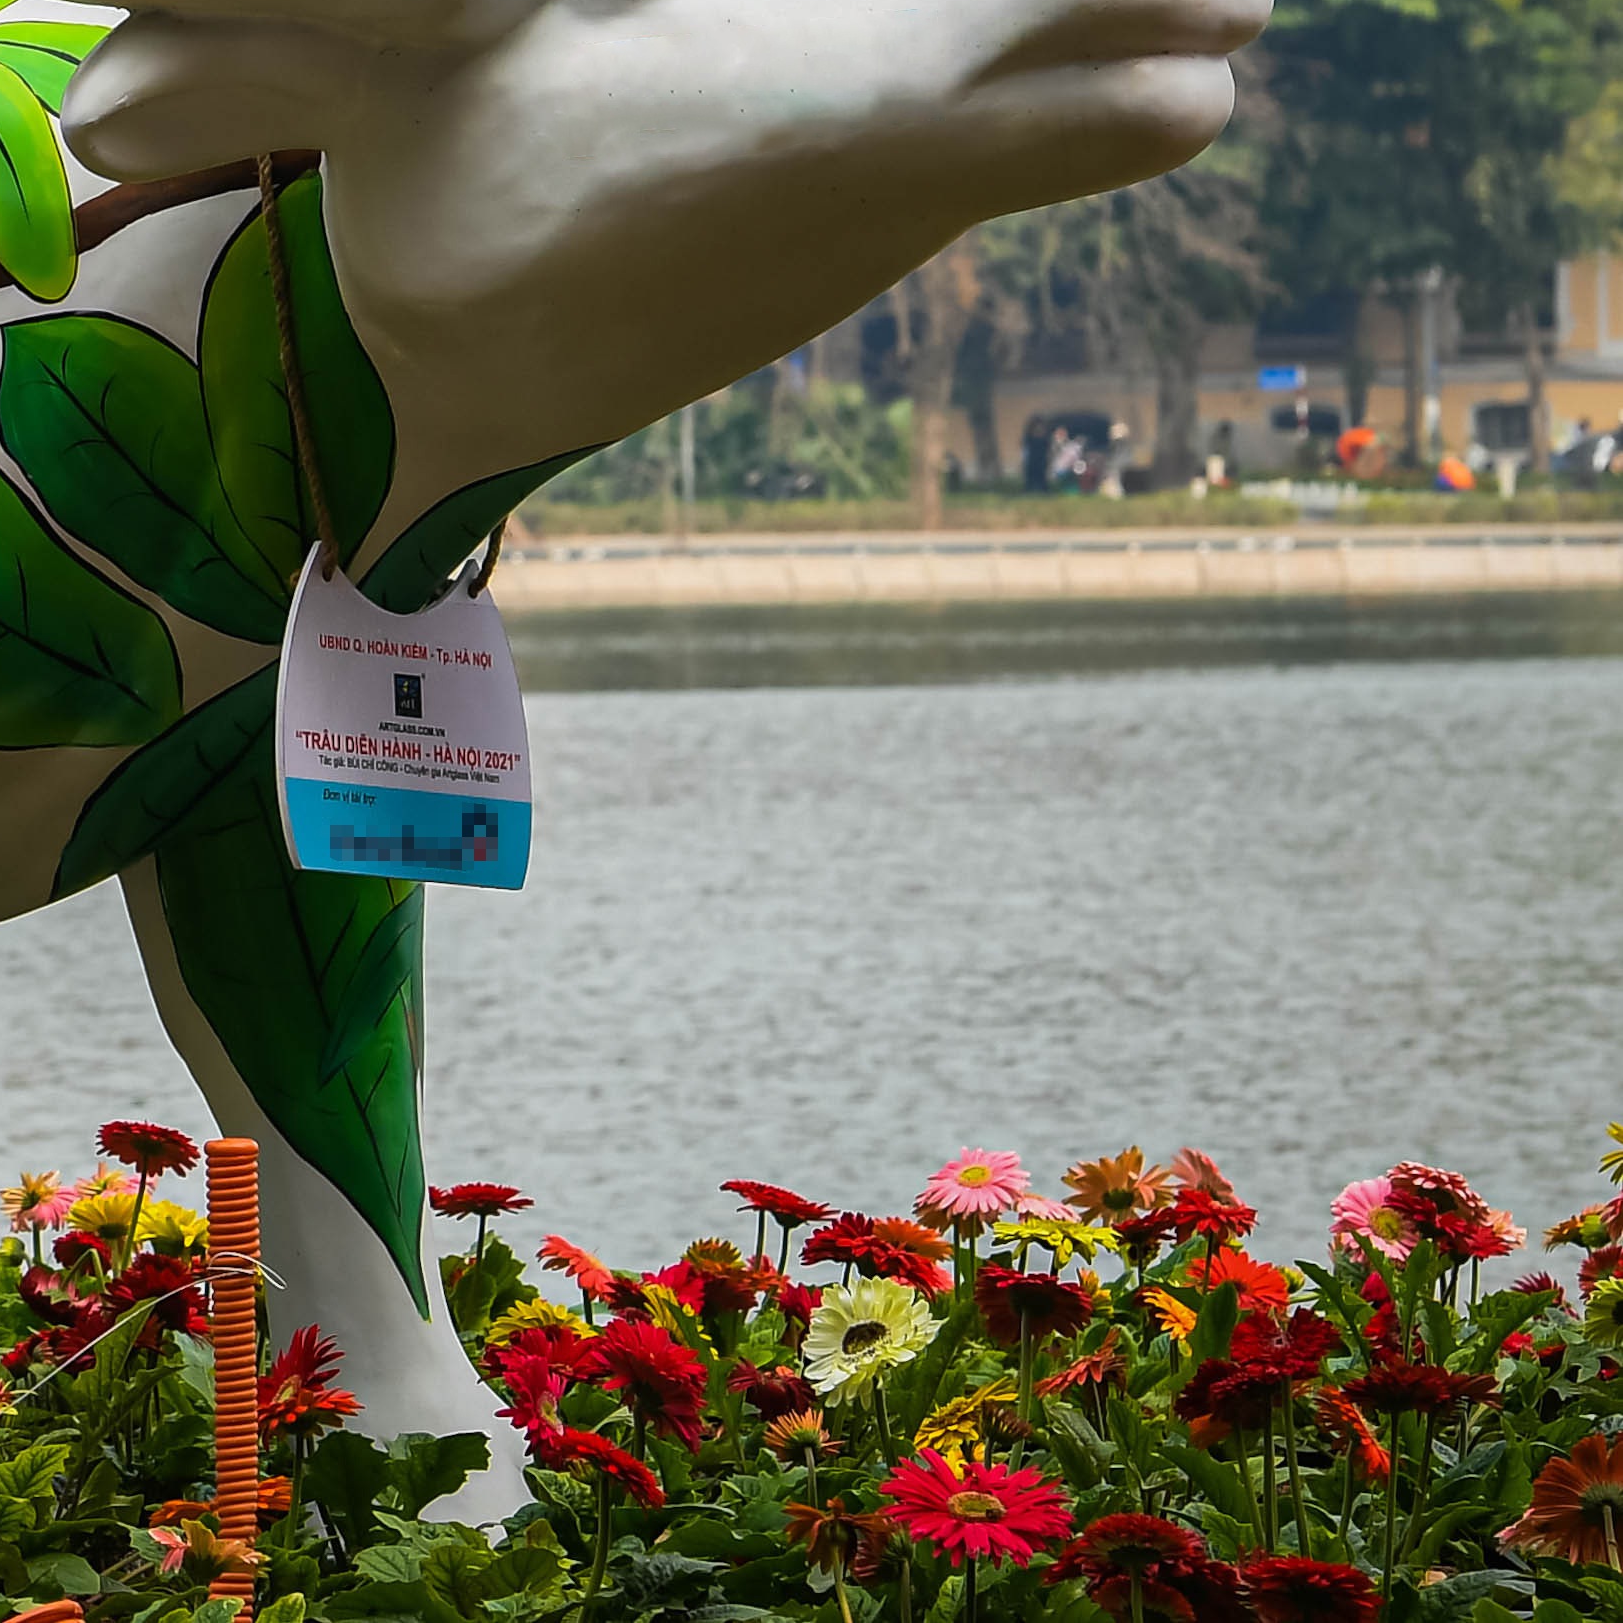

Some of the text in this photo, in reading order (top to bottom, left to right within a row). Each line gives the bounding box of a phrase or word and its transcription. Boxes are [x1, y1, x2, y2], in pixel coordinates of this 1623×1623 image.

[319, 634, 350, 651] UBND
[353, 639, 365, 652] Q.
[367, 638, 398, 657] HOÀN
[436, 648, 452, 665] Tp.
[455, 648, 470, 665] HÀ
[379, 721, 446, 737] ARTGLASS.COM.VN
[381, 736, 422, 761] HÀNH
[434, 741, 453, 765] HÀ
[457, 746, 482, 770] NỘI
